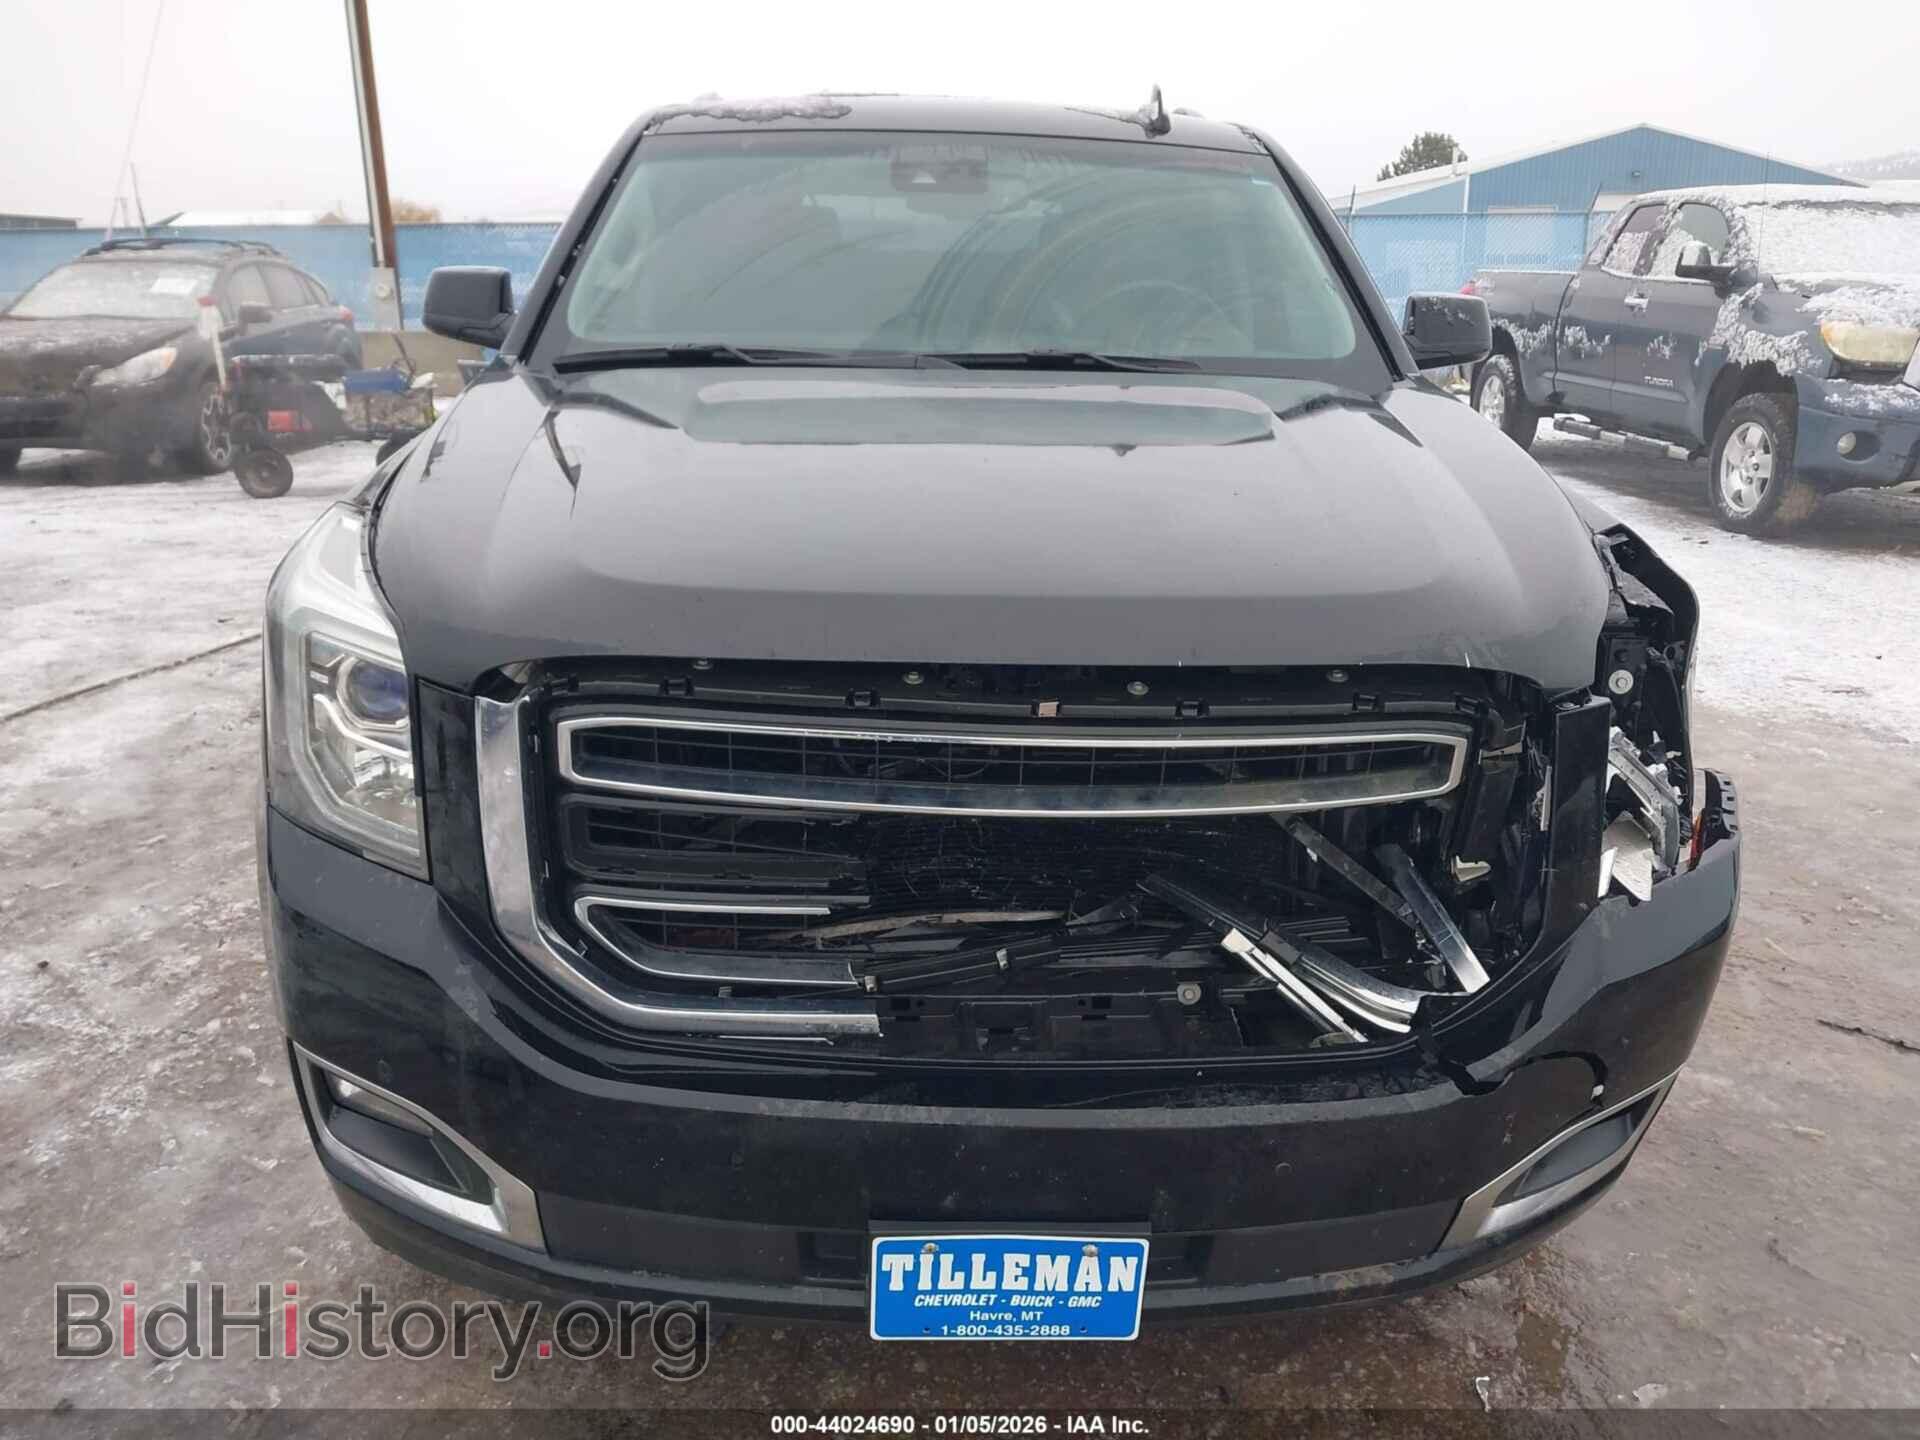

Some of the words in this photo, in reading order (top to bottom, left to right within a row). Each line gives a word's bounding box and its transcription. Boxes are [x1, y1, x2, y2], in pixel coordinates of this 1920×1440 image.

[881, 1252, 1139, 1292] TILLEMAN
[914, 1294, 998, 1307] CHEVROLET
[1010, 1295, 1055, 1307] BUICK
[1067, 1296, 1103, 1308] GMC
[969, 1310, 1018, 1323] Havre,
[1021, 1311, 1045, 1321] MT
[940, 1325, 1071, 1336] 1-800-435-2888
